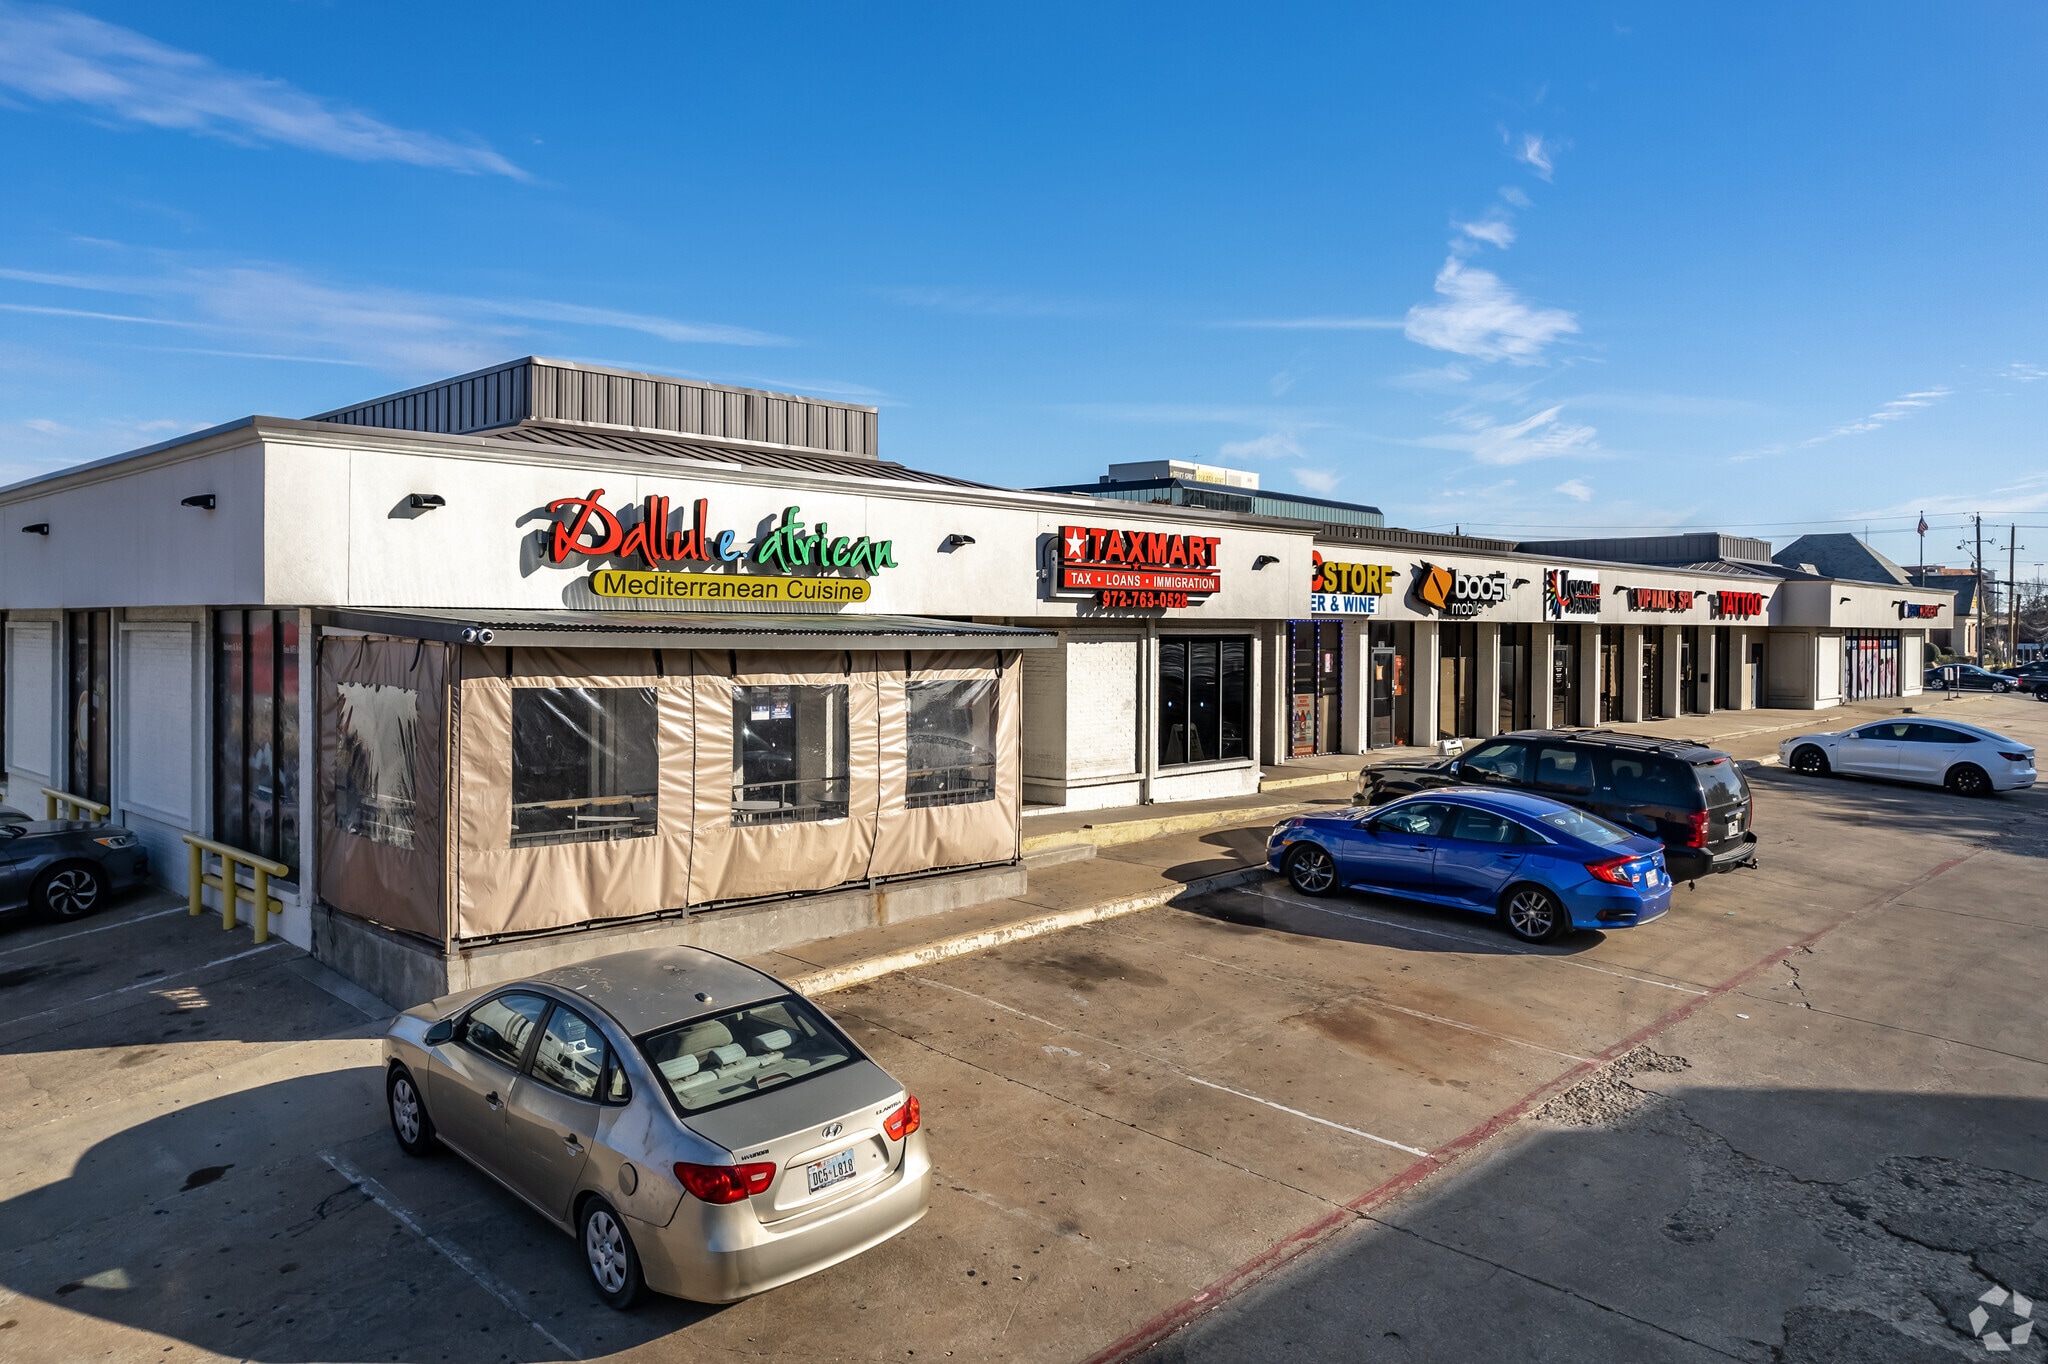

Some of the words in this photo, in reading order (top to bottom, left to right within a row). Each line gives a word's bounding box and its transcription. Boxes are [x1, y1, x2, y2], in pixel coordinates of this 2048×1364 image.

[549, 488, 711, 568] Dallul
[758, 505, 899, 577] african
[1089, 527, 1221, 567] TAXMART
[603, 572, 779, 599] Mediterranean
[786, 579, 864, 601] Cuisine
[1071, 572, 1092, 585] TAX
[1106, 574, 1141, 587] LOANS
[1153, 575, 1216, 590] IMMIGRATION
[1323, 560, 1393, 594] STORE
[1455, 568, 1511, 601] boost
[1102, 590, 1188, 609] 972-763-0528
[1330, 595, 1340, 612] &
[1343, 596, 1375, 613] WINE
[1451, 602, 1483, 616] mobile
[1720, 590, 1763, 616] TATTOO
